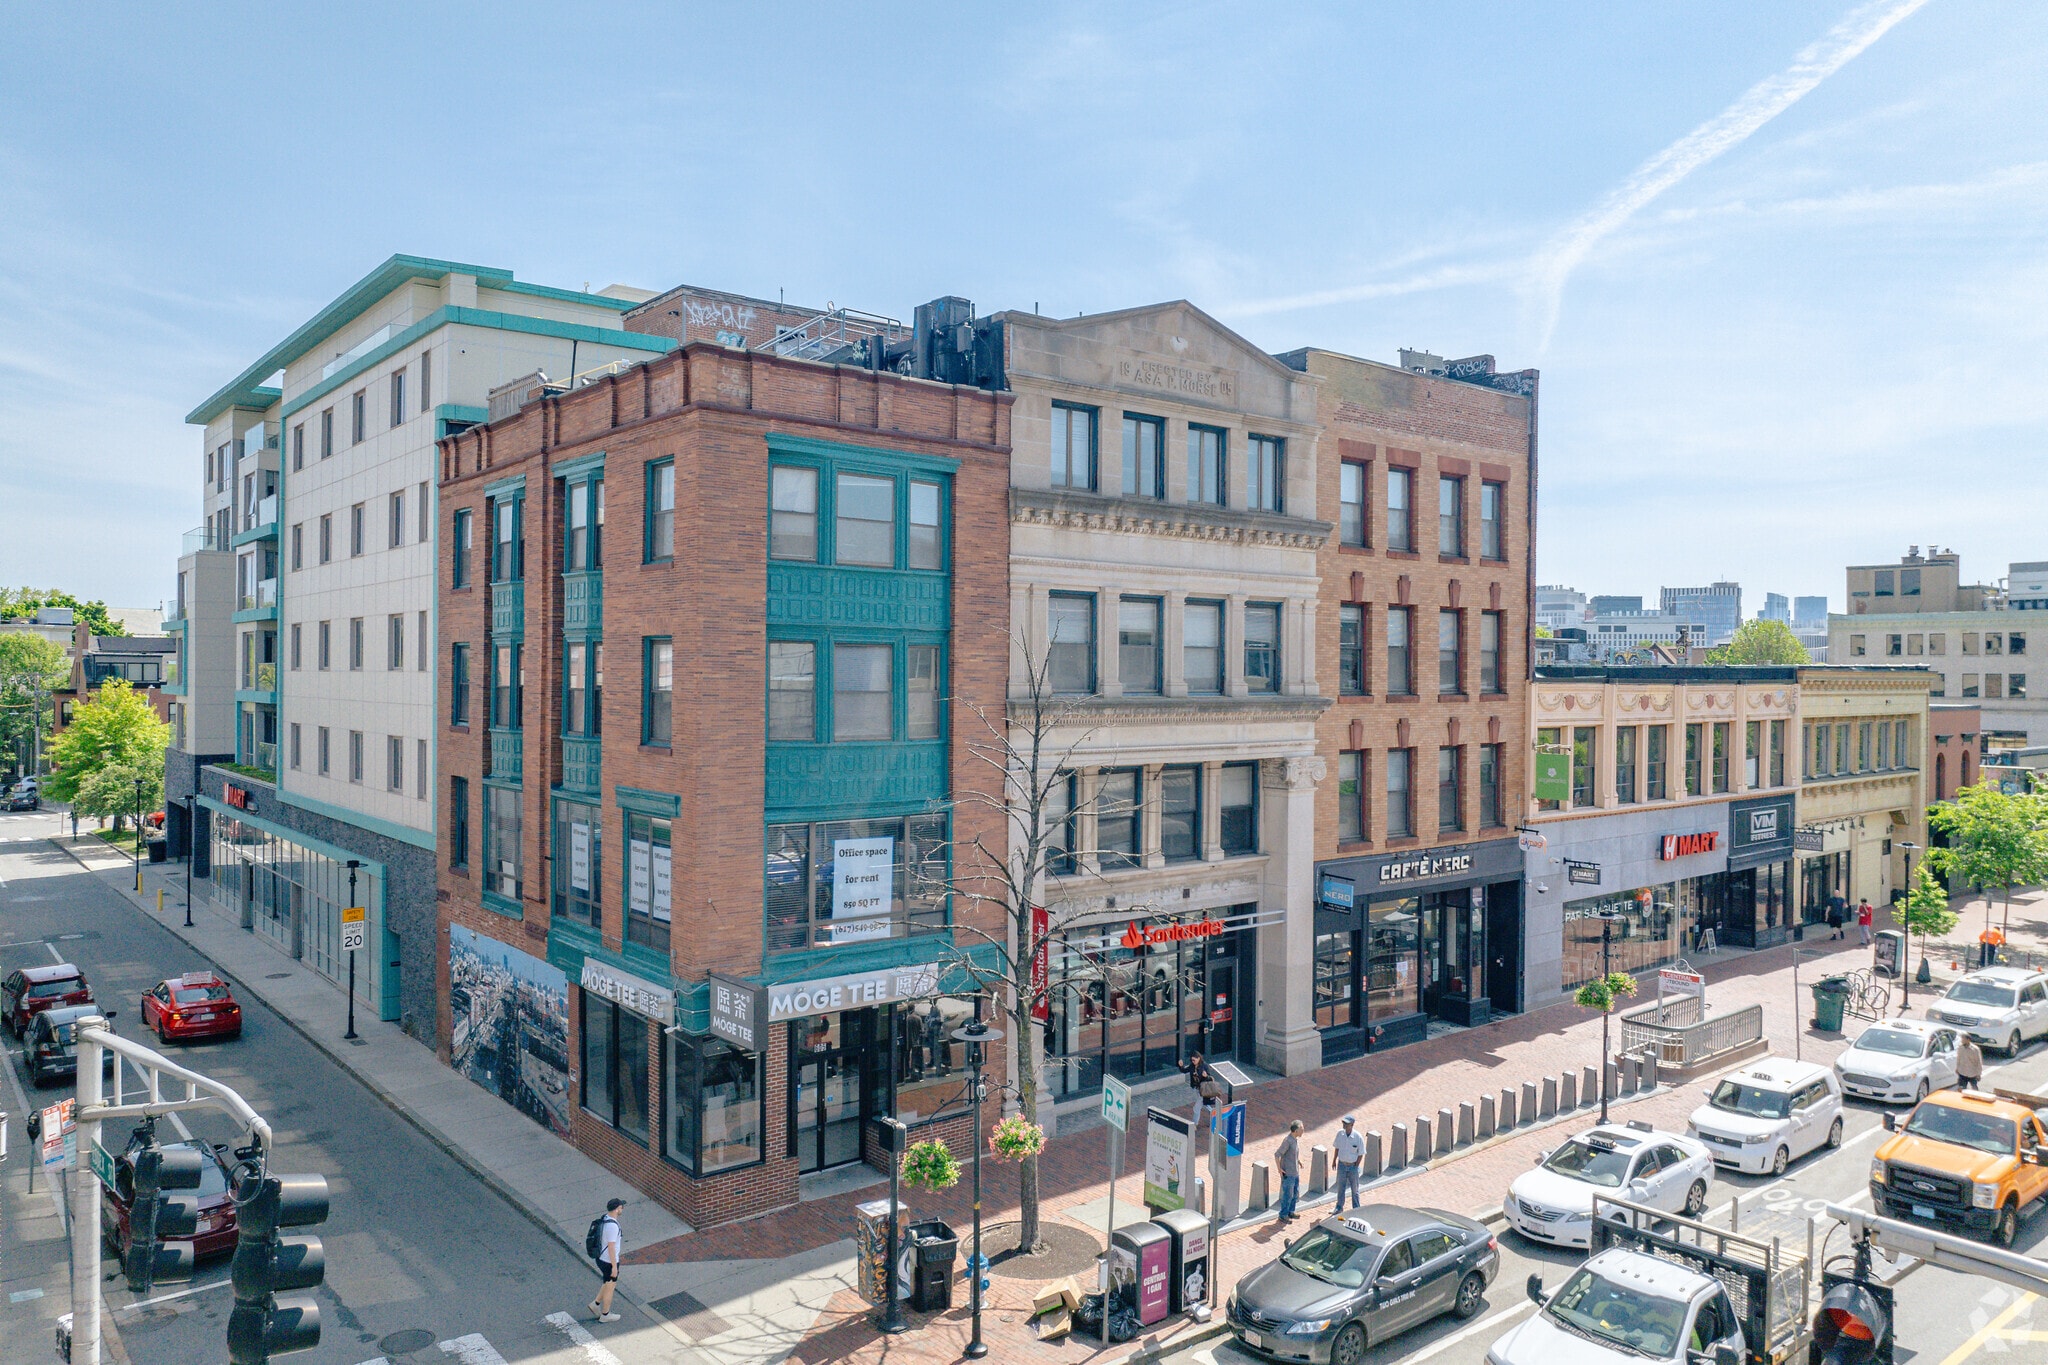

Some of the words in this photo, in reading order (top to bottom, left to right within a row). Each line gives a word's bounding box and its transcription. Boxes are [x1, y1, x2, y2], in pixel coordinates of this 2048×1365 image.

[1120, 361, 1130, 376] 19
[1142, 361, 1192, 380] ERECTED
[1197, 373, 1211, 383] BY
[1135, 369, 1161, 387] ASA
[1180, 379, 1216, 397] MORSE
[1221, 381, 1232, 396] 05
[1754, 814, 1775, 829] VIM
[1751, 831, 1777, 841] FITNESS
[1798, 835, 1820, 843] VIM
[1679, 831, 1719, 857] MART
[839, 848, 863, 857] Office
[865, 848, 888, 858] space
[845, 875, 858, 883] for
[860, 874, 879, 882] rent
[843, 900, 856, 908] 850
[857, 899, 868, 908] SQ
[869, 898, 880, 906] FT
[1324, 891, 1350, 901] NERO
[1144, 917, 1226, 946] Santander
[344, 935, 362, 947] 20
[1666, 973, 1692, 982] CENTRAL
[614, 982, 635, 1008] TEE
[848, 980, 887, 1004] TEE
[738, 1026, 752, 1042] TEE
[1754, 1072, 1771, 1081] TAXI
[1152, 1131, 1182, 1149] COMPOST
[1348, 1219, 1366, 1232] TAXI
[1188, 1237, 1203, 1247] DANCE
[1193, 1243, 1206, 1253] NIGHT
[1151, 1265, 1159, 1274] IN
[1144, 1271, 1166, 1287] CENTRAL
[1147, 1286, 1151, 1295] I
[1150, 1281, 1162, 1294] CAN
[1379, 1301, 1389, 1310] TWO
[1389, 1296, 1400, 1306] GIRLS
